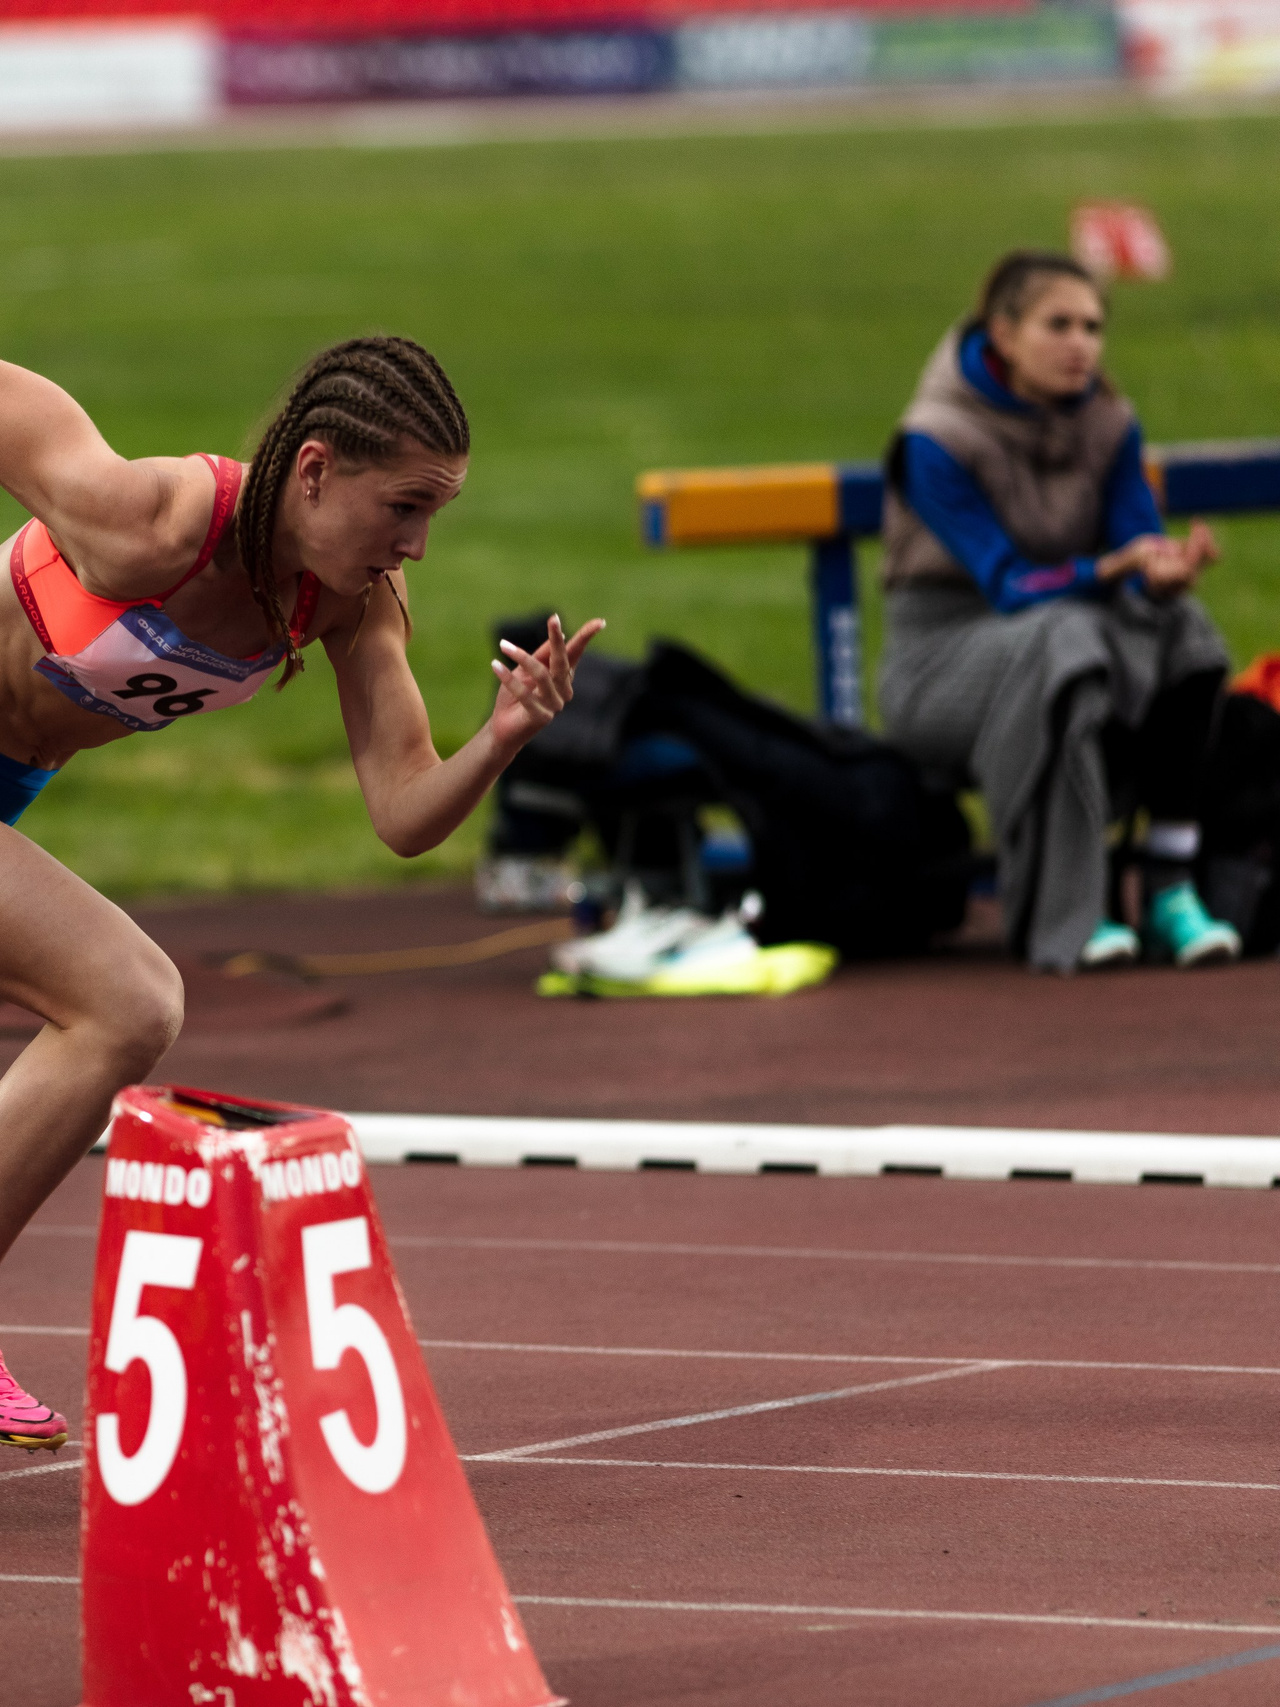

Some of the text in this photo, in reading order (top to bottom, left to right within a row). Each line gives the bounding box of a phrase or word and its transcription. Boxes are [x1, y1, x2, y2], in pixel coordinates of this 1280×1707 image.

[211, 484, 232, 540] UNDER
[15, 572, 49, 643] ARMOUR
[111, 673, 219, 717] 96
[106, 1157, 212, 1208] MONDO
[260, 1149, 361, 1201] MONDO
[95, 1229, 203, 1506] 5
[301, 1216, 407, 1494] 5
